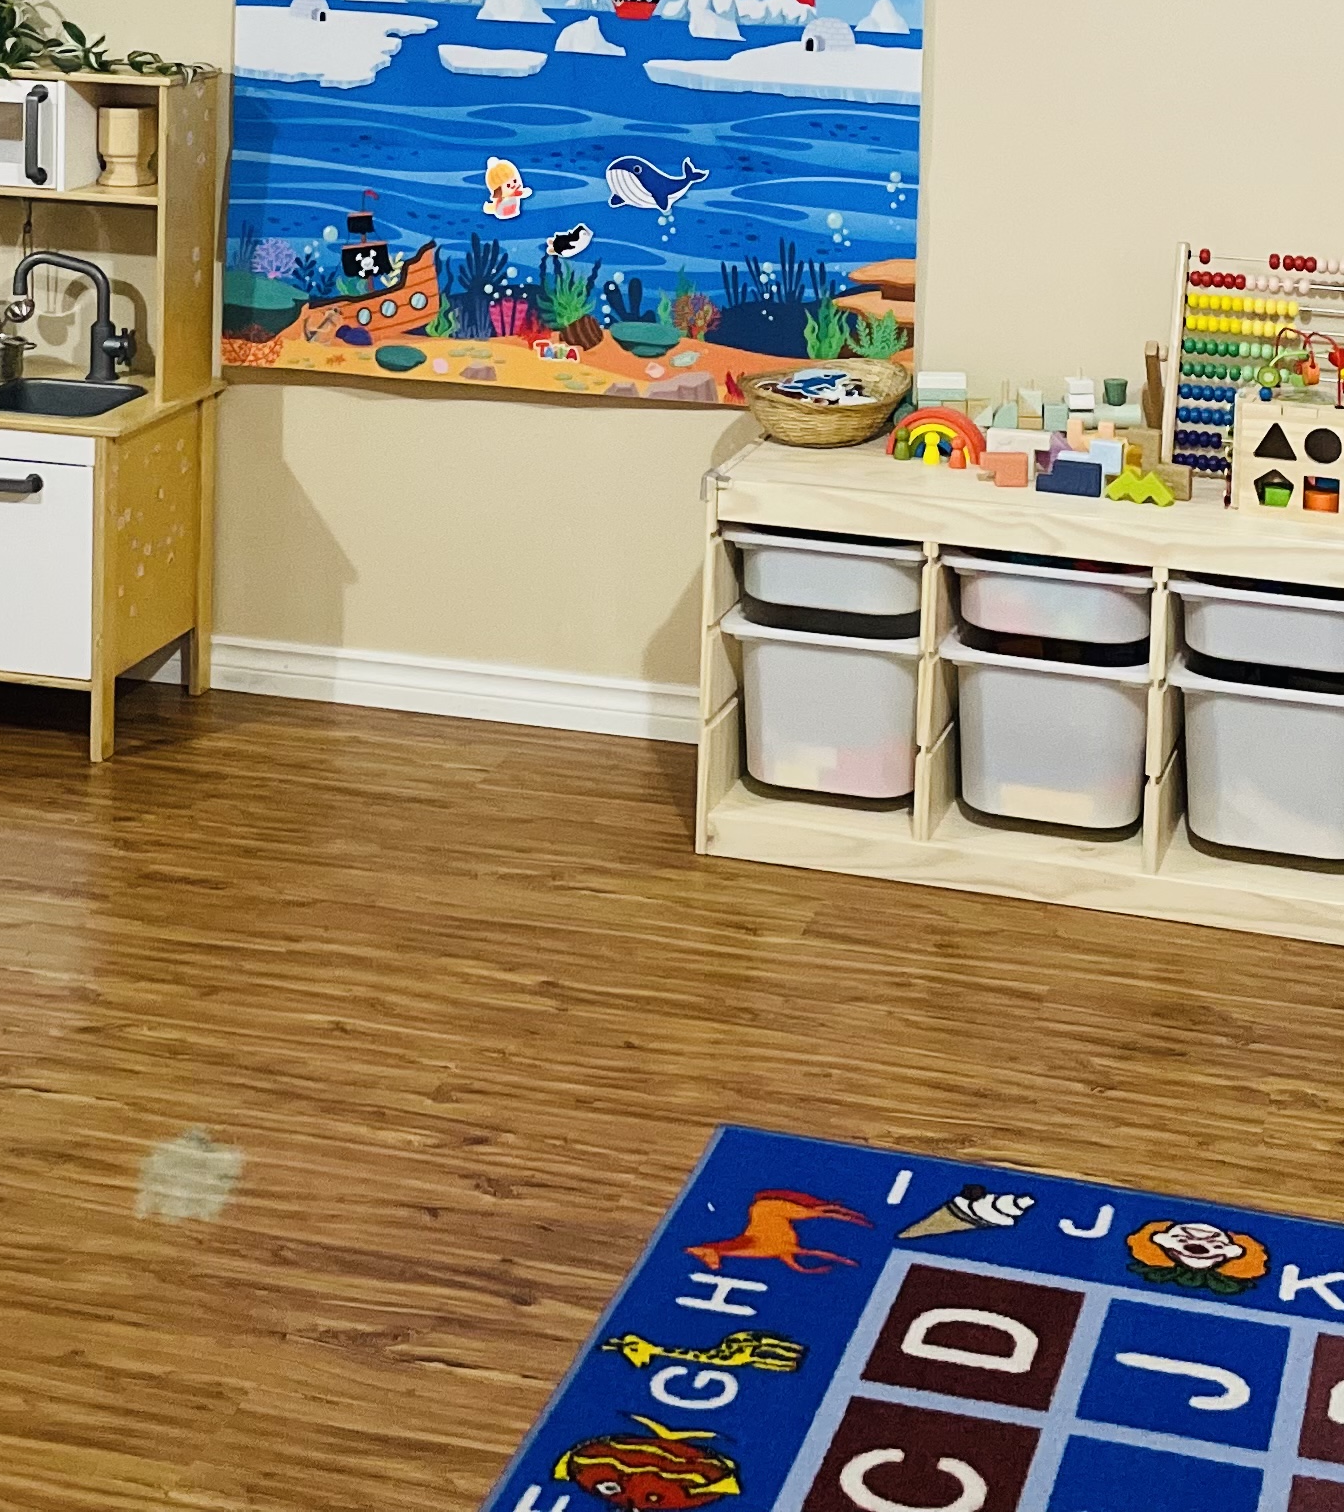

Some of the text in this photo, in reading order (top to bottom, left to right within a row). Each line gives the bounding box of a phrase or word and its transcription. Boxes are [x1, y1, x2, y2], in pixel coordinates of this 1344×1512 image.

[1058, 1204, 1115, 1239] J
[675, 1272, 768, 1317] H
[900, 1307, 1040, 1374] D
[1114, 1351, 1251, 1411] J
[650, 1365, 739, 1410] G
[839, 1447, 988, 1512] C
